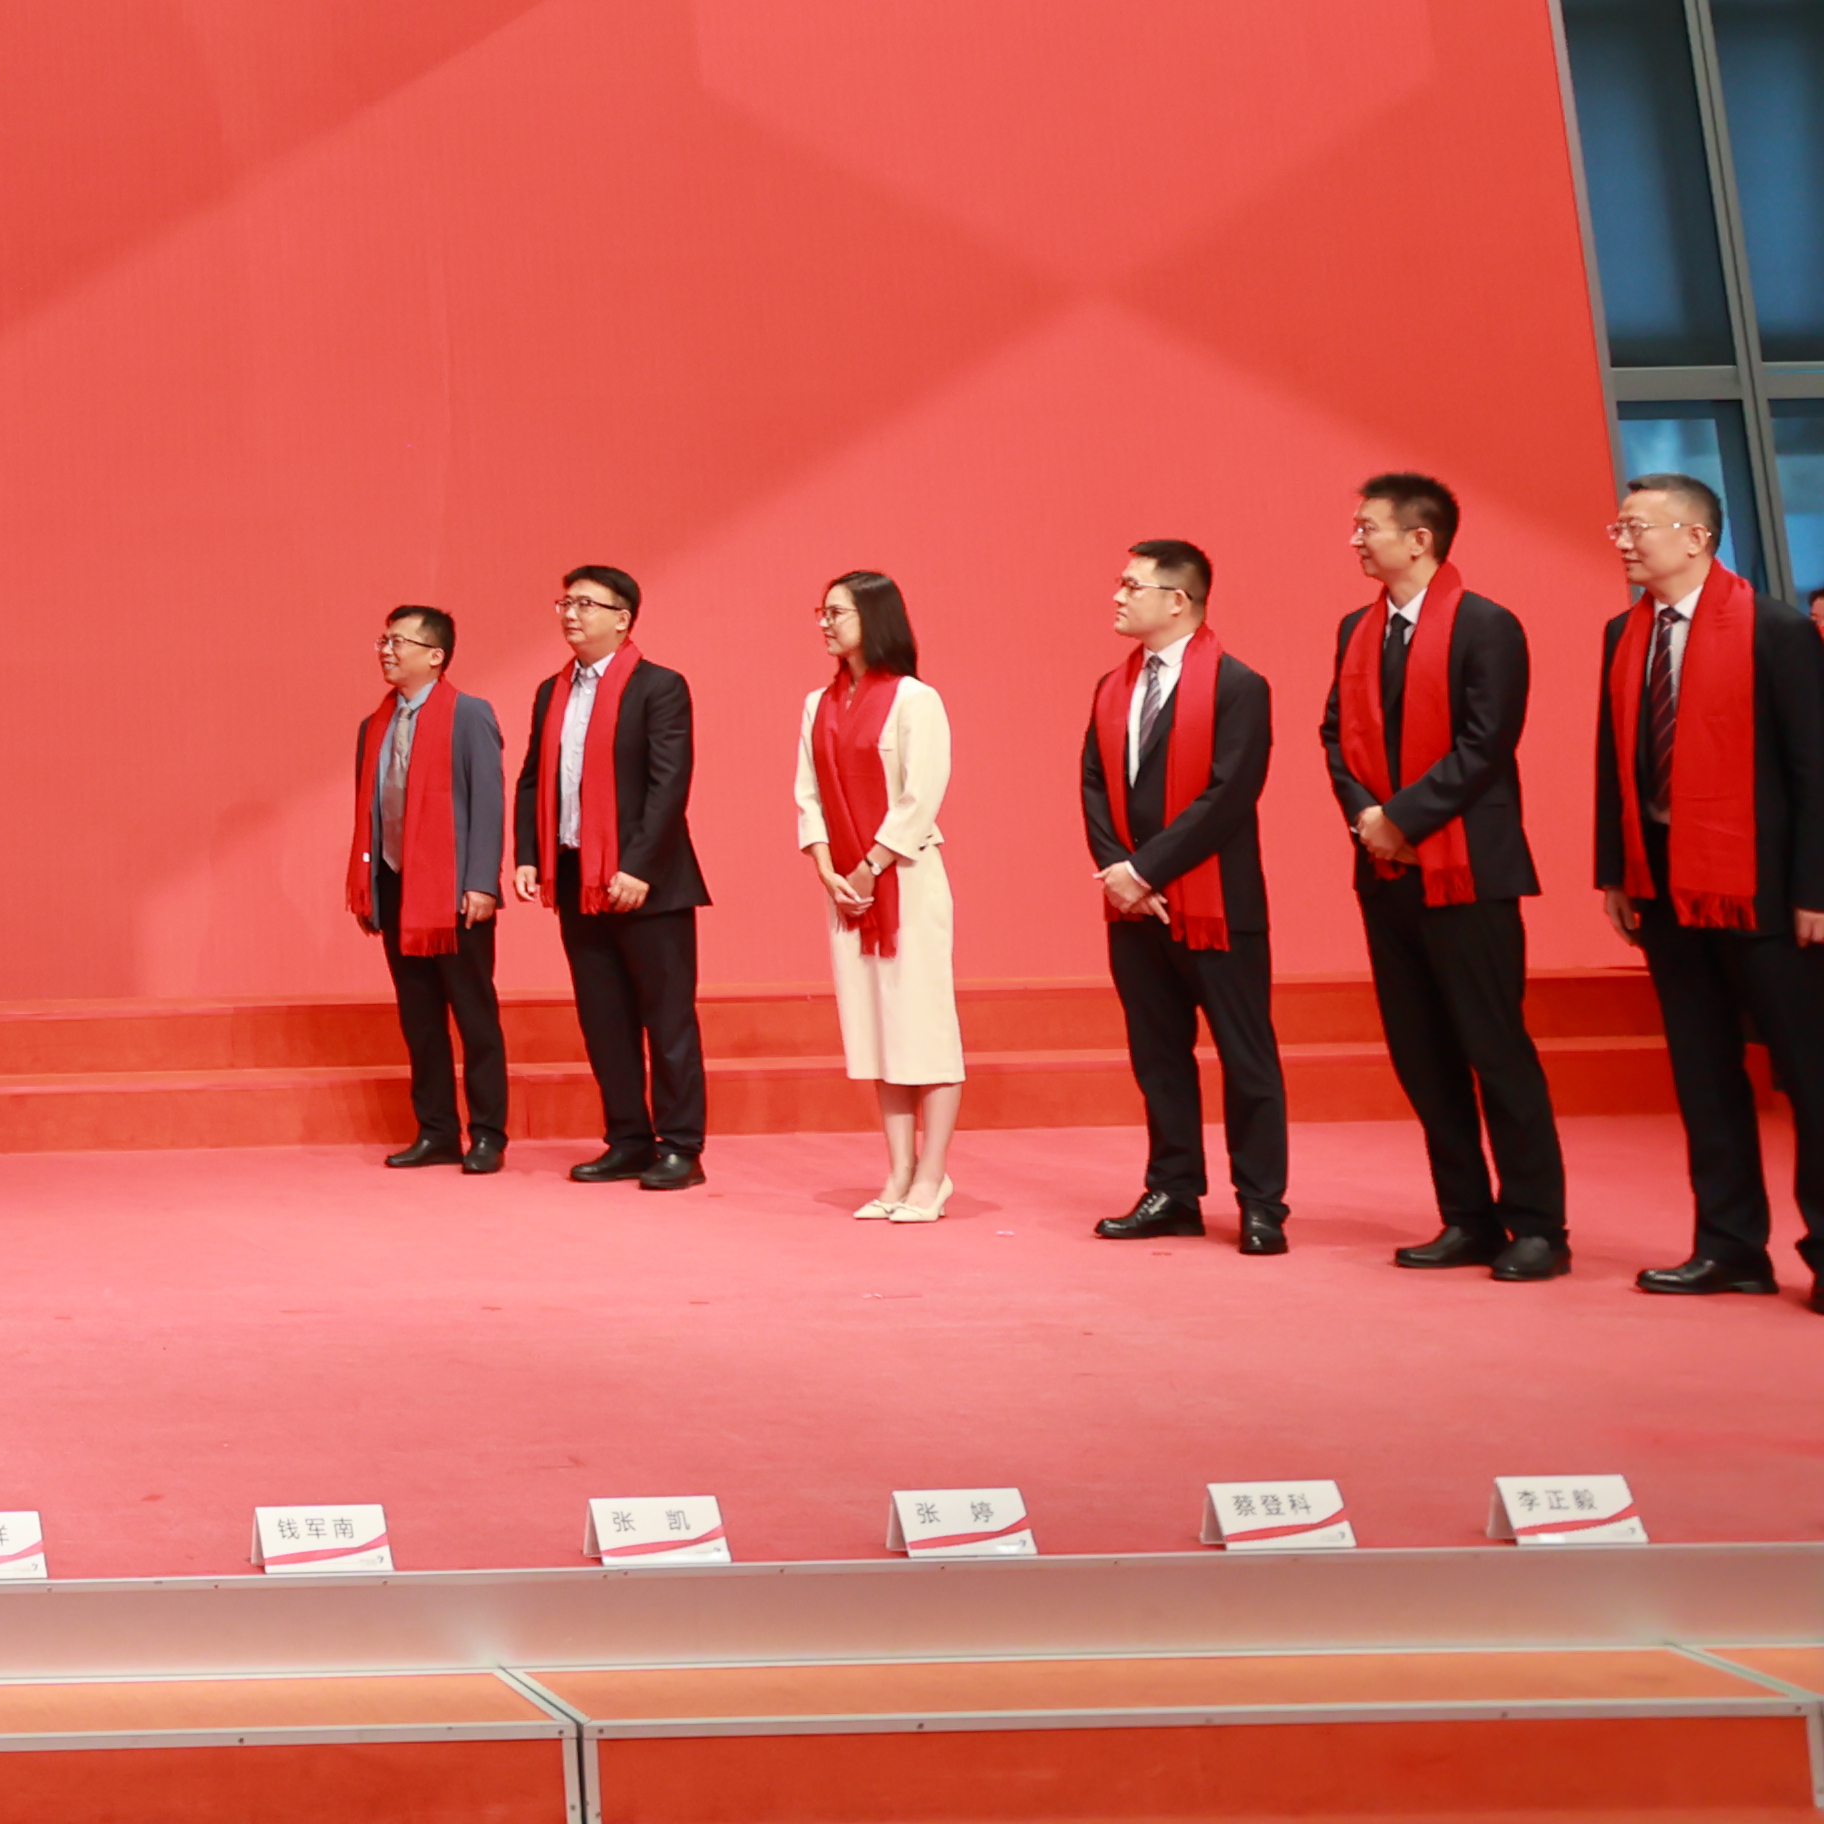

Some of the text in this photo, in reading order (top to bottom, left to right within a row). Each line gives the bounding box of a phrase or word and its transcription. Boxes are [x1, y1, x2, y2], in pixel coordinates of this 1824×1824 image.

[1232, 1493, 1312, 1517] 蔡登科
[277, 1517, 354, 1539] 钱军南
